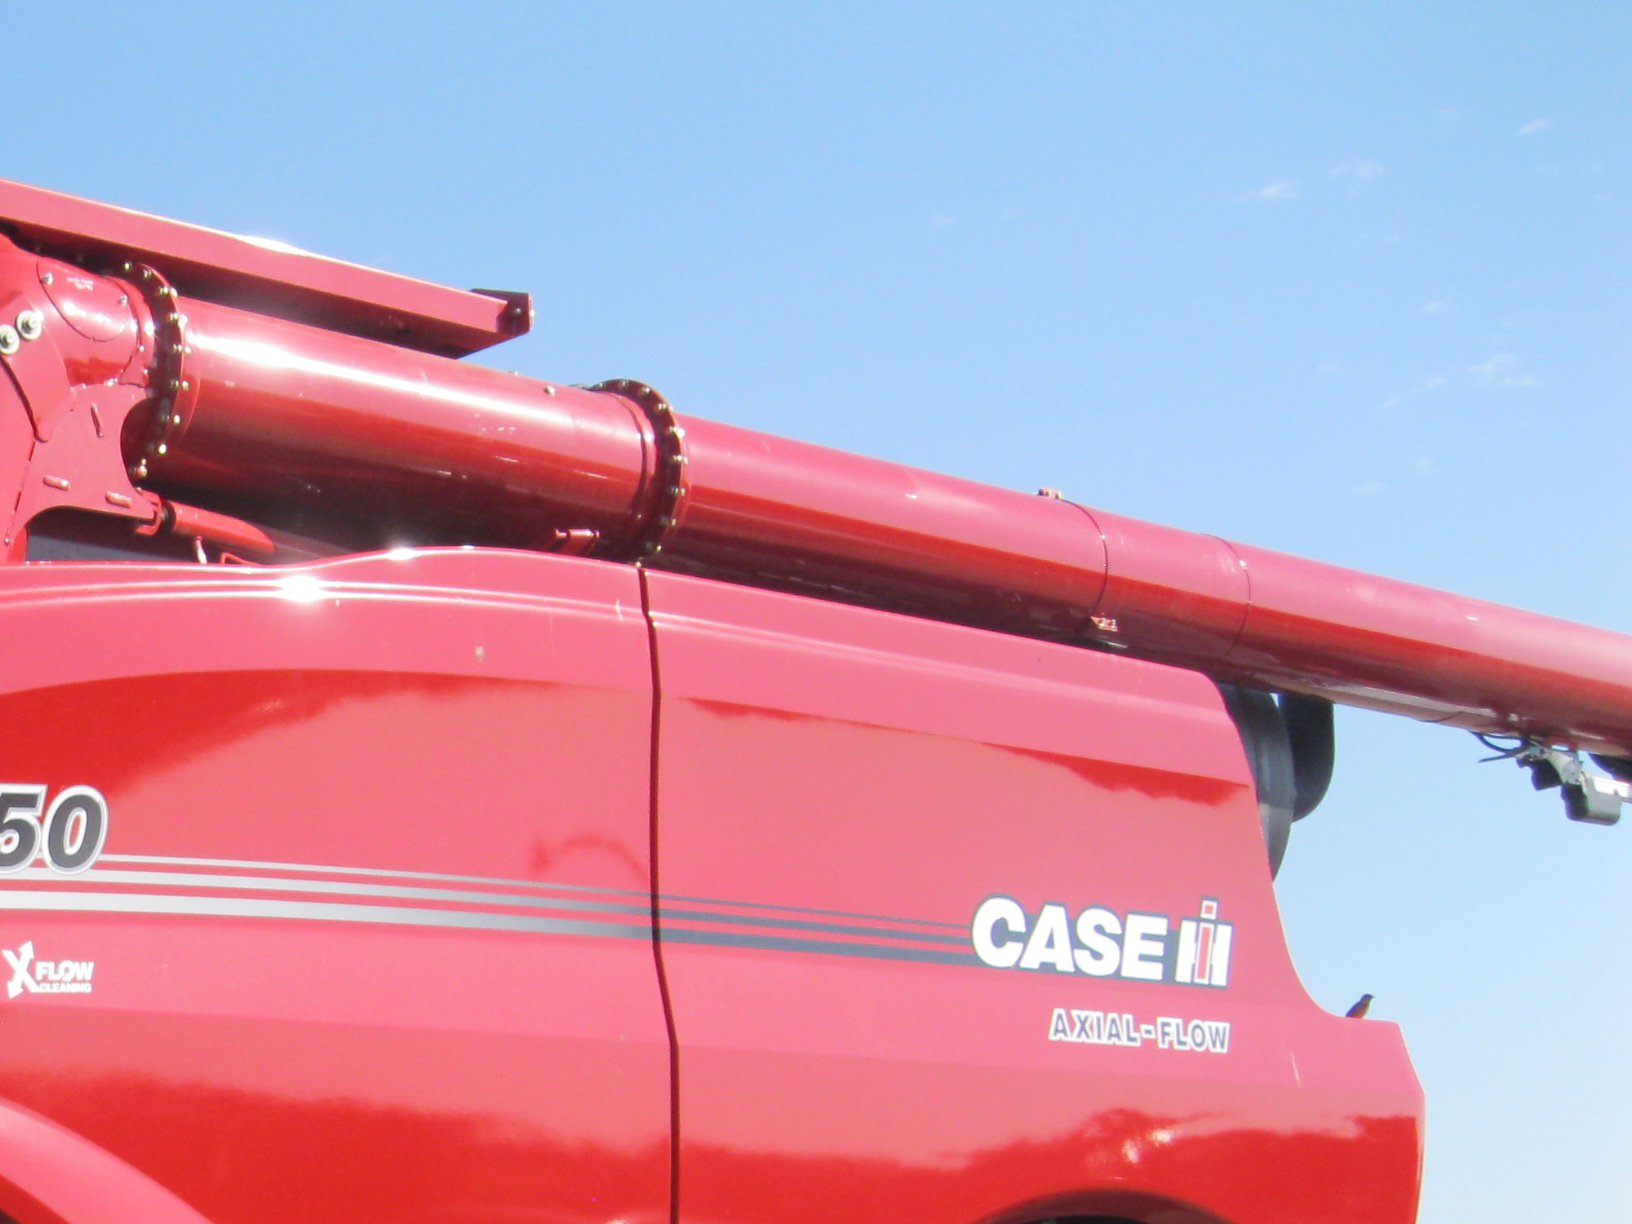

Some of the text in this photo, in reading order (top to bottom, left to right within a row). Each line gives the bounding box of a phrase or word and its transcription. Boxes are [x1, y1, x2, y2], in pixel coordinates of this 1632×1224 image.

[971, 895, 1168, 981] CASE
[35, 960, 95, 982] FLOW
[38, 982, 94, 994] CLEANING
[1048, 1007, 1231, 1054] AXIAL-FLOW
